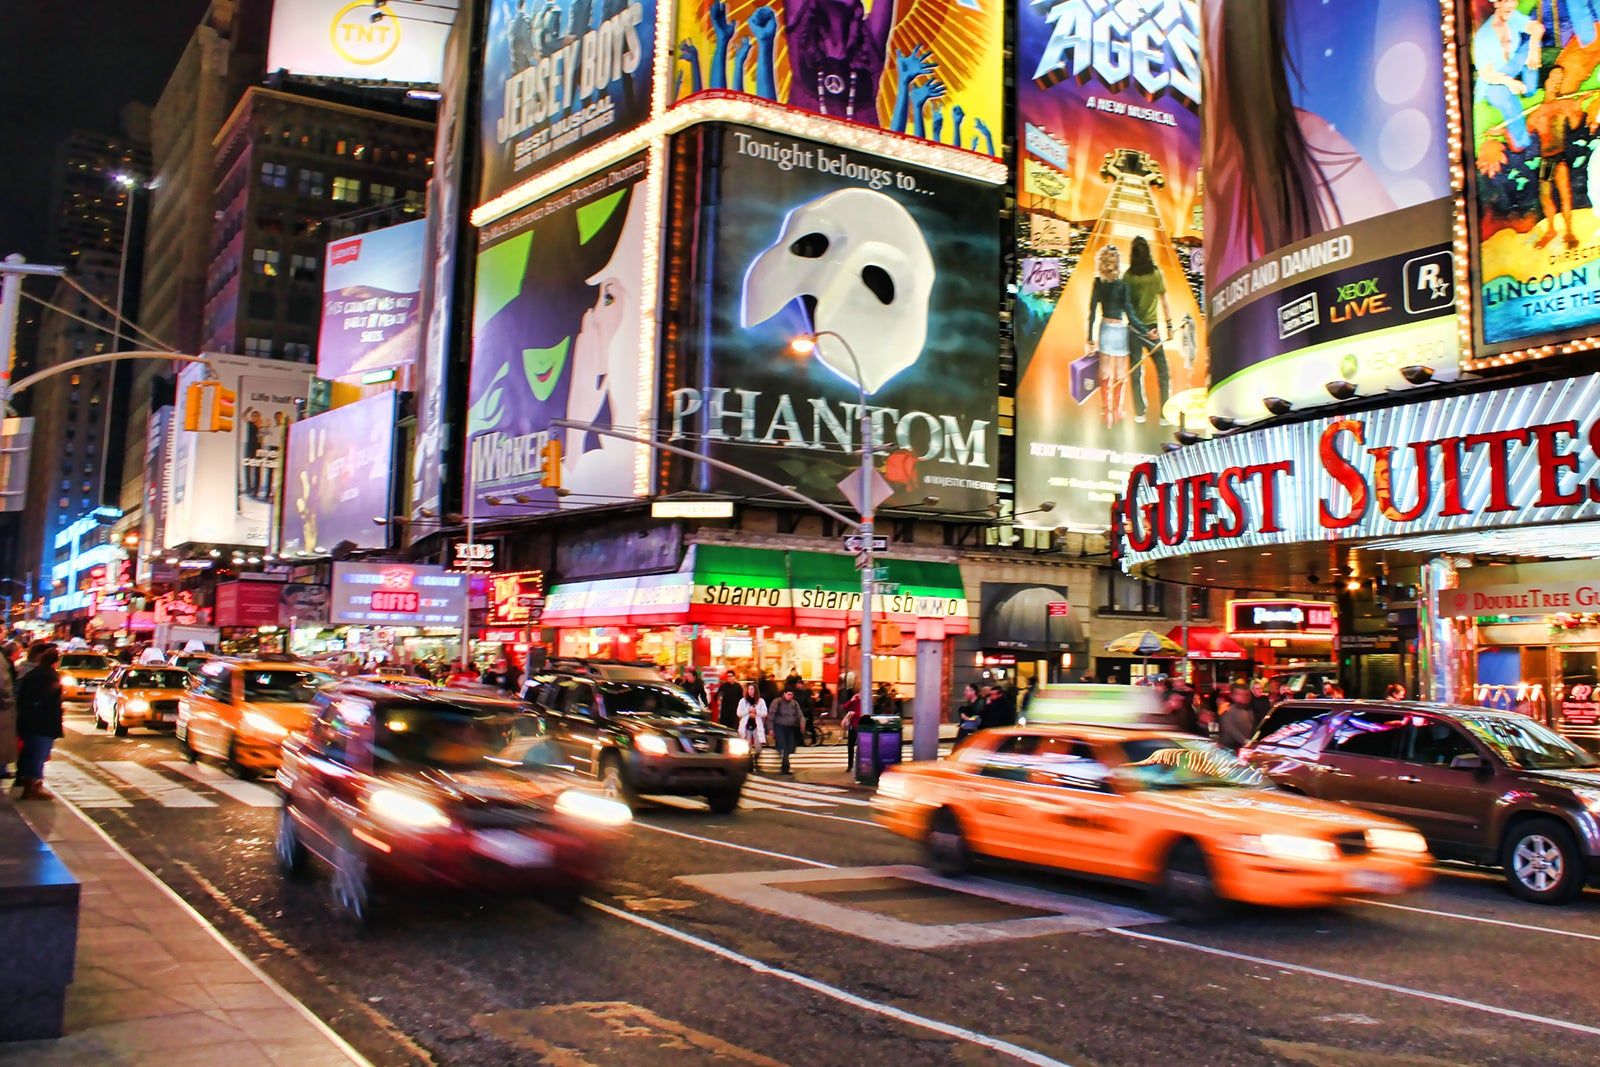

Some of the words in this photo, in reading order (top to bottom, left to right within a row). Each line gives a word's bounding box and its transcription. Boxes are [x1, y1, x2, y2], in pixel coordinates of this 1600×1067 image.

[342, 23, 390, 43] TNT
[497, 39, 580, 143] JERSEY
[580, 2, 643, 99] BOYS
[1031, 3, 1201, 108] AGES
[515, 127, 551, 158] BEST
[551, 95, 615, 139] MUSICAL
[1085, 96, 1096, 109] A
[1097, 98, 1126, 115] NEW
[1127, 104, 1178, 127] MUSICAL
[733, 131, 814, 171] Tonight
[817, 148, 893, 190] belongs
[895, 171, 935, 196] to...
[1226, 273, 1250, 307] LOST
[1250, 260, 1280, 293] AND
[1281, 235, 1354, 279] DAMNED
[1335, 277, 1380, 303] XBOX
[1485, 267, 1587, 306] LINCOLN
[1329, 293, 1388, 323] LIVE
[1522, 297, 1566, 317] TAKE
[668, 387, 990, 468] PHANTOM
[1123, 459, 1294, 552] GUEST
[371, 592, 417, 612] GIFTS
[703, 581, 780, 607] sbarro
[801, 584, 864, 609] sbarr
